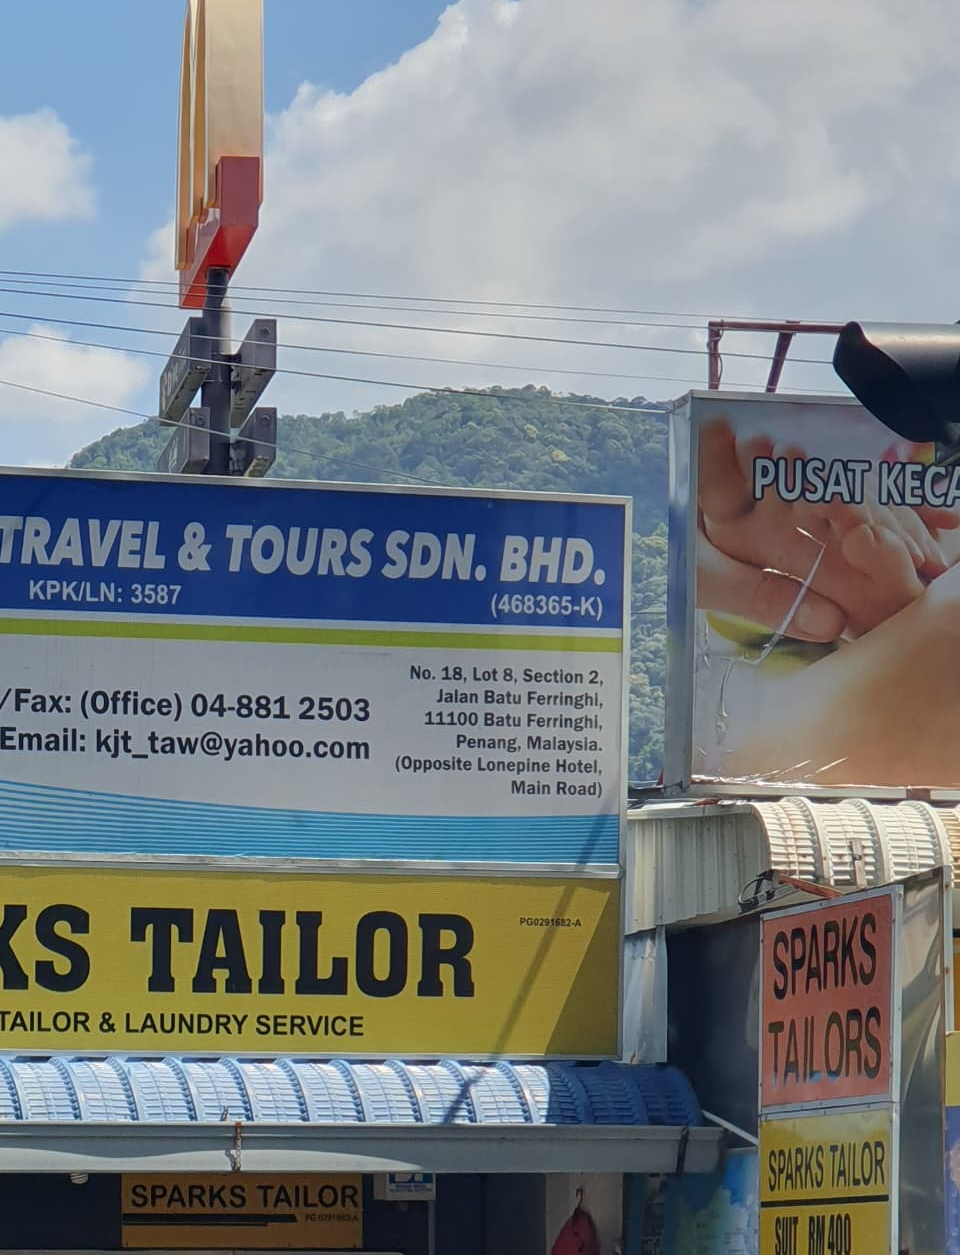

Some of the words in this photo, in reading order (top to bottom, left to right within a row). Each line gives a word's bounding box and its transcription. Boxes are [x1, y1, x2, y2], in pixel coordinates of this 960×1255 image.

[753, 457, 871, 504] PUSAT
[178, 522, 212, 571] &
[225, 523, 375, 579] TOURS
[381, 531, 487, 582] SDN.
[499, 535, 606, 586] BHD.
[28, 580, 123, 603] KPK/LN:
[130, 583, 182, 605] 3587
[491, 593, 603, 621] (468365-K)
[410, 665, 436, 681] No.
[441, 666, 465, 684] 18,
[473, 667, 497, 682] Lot
[503, 668, 518, 685] 8,
[523, 668, 583, 684] Section
[589, 670, 604, 687] 2,
[79, 690, 182, 722] (Office)
[191, 693, 291, 720] 04-881
[298, 697, 371, 722] 2503
[436, 688, 479, 704] Jalan
[484, 689, 521, 706] Batu
[527, 690, 603, 711] Ferringhi,
[424, 711, 478, 727] 11100
[484, 712, 521, 728] Batu
[527, 713, 603, 732] Ferringhi,
[0, 727, 86, 753] Email:
[95, 730, 370, 761] kjt_taw@yahoo.com
[456, 734, 522, 754] Penang,
[527, 735, 603, 755] Malaysia.
[394, 755, 472, 775] (Opposite
[477, 756, 551, 775] Lonepine
[555, 757, 602, 777] Hotel,
[510, 780, 552, 796] Main
[557, 780, 603, 799] Road)
[130, 906, 475, 998] TAILOR
[773, 912, 877, 1001] SPARKS
[98, 1012, 117, 1033] &
[125, 1012, 248, 1035] LAUNDRY
[256, 1015, 365, 1037] SERVICE
[768, 1006, 882, 1087] TAILORS
[768, 1145, 824, 1192] SPARKS
[830, 1140, 886, 1188] TAILOR
[130, 1184, 247, 1209] SPARKS
[256, 1184, 359, 1209] TAILOR
